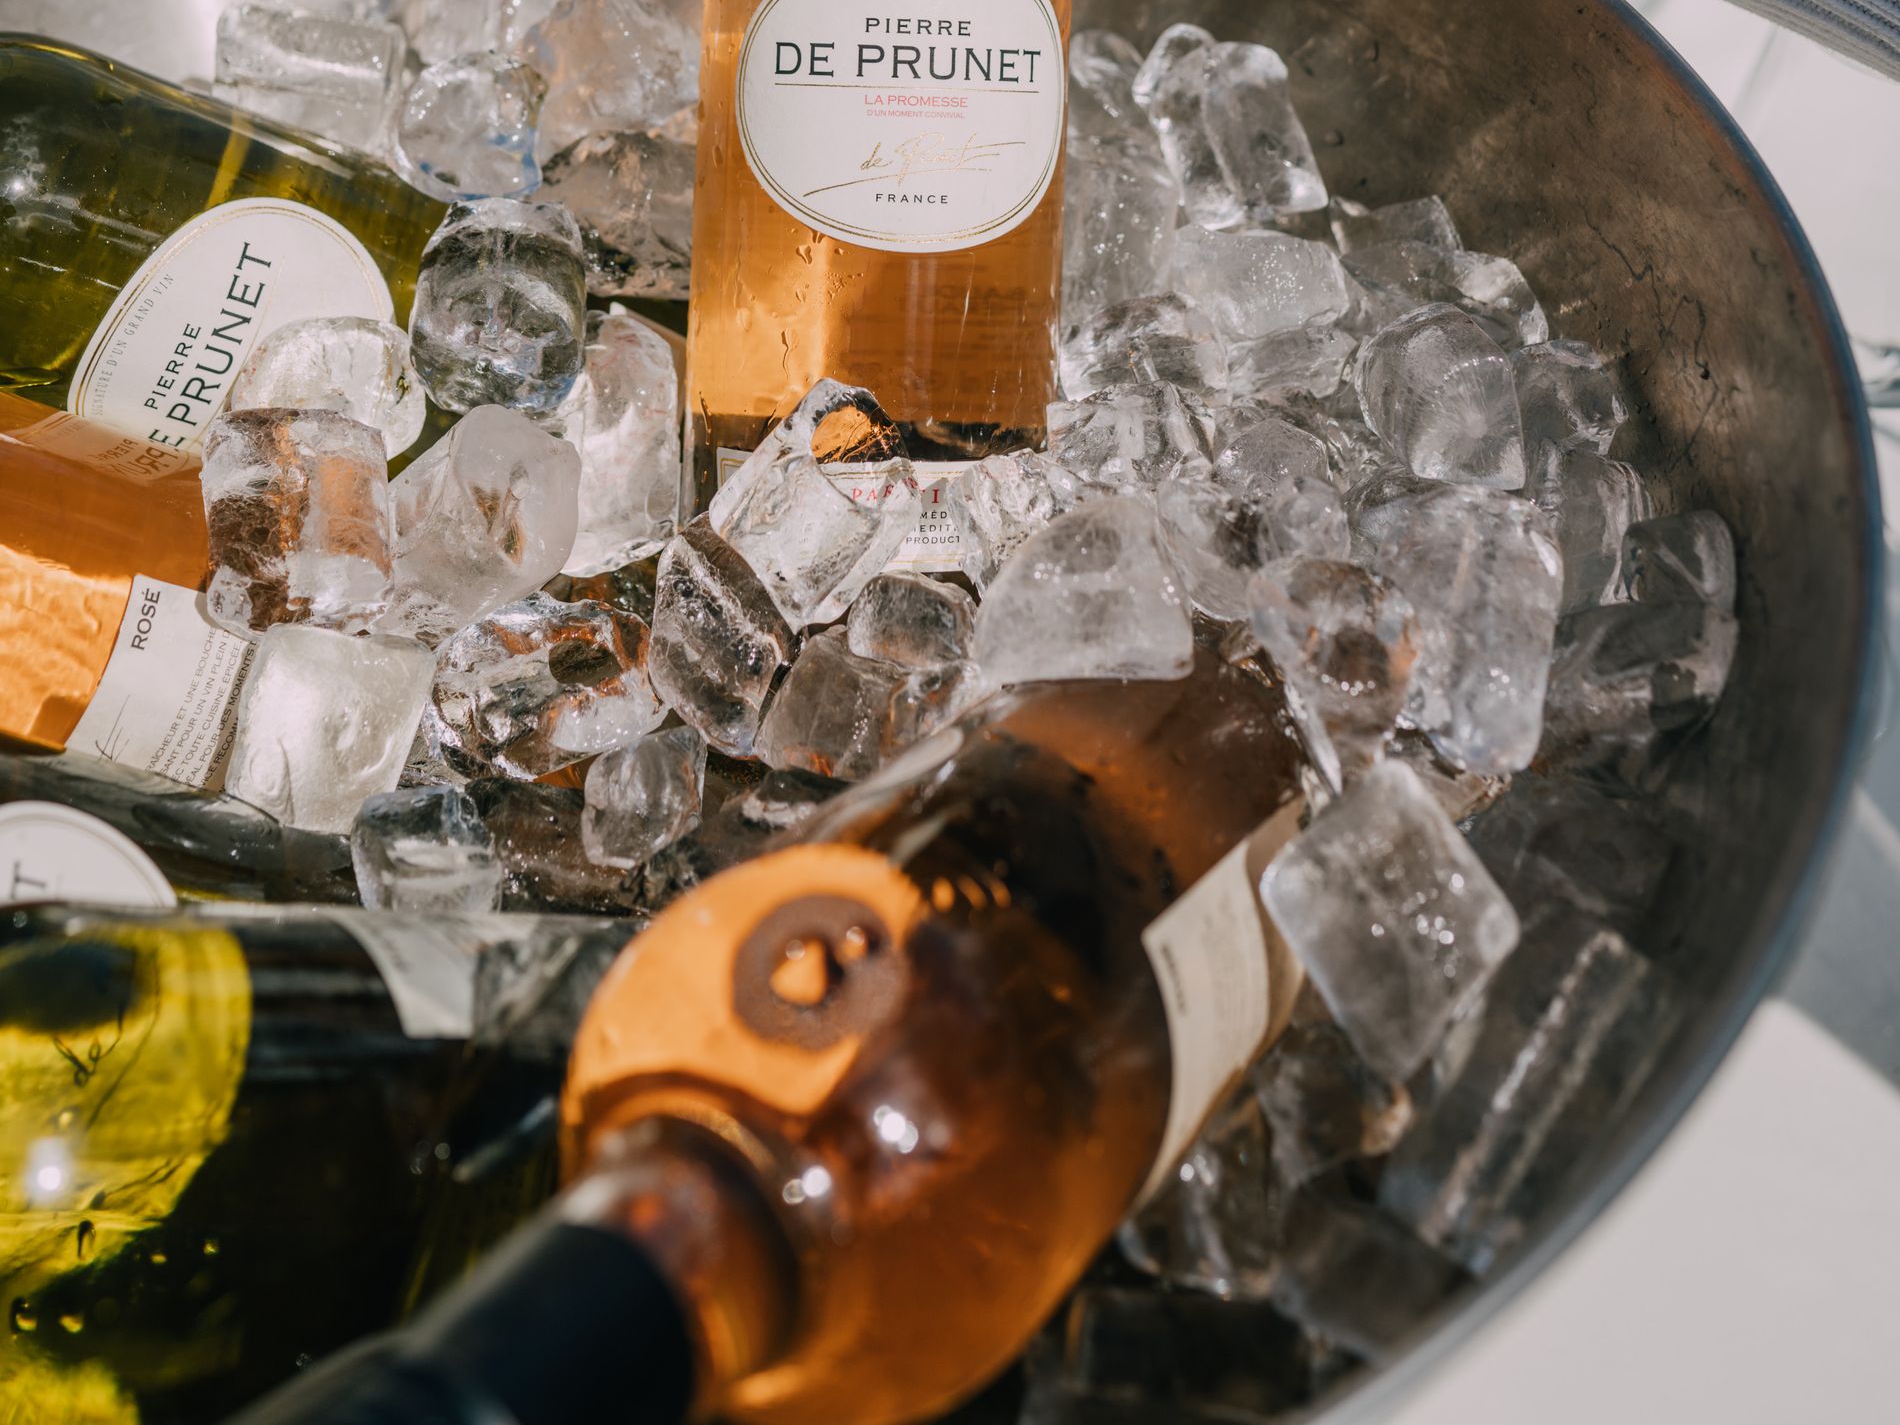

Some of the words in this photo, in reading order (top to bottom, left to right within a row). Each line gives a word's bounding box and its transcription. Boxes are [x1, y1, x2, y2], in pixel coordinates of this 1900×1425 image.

[865, 17, 971, 36] PIERRE
[774, 42, 835, 77] DE
[856, 44, 1041, 83] PRUNET
[864, 94, 885, 106] LA
[888, 95, 969, 108] PROMESSE
[888, 110, 924, 118] MOMENT
[875, 193, 949, 204] FRANCE
[106, 338, 127, 367] D'UN
[123, 298, 154, 336] GRAND
[152, 272, 174, 294] VIN
[166, 242, 272, 427] PRUNET
[144, 323, 201, 410] PIERRE
[131, 588, 160, 650] ROSÉ
[176, 705, 187, 719] ET
[184, 678, 199, 703] UNE
[177, 717, 197, 747] POUR
[194, 698, 206, 715] UN
[202, 676, 215, 696] VIN
[210, 640, 227, 674] PLEIN
[181, 732, 204, 763] TOUTE
[202, 686, 225, 730] CUISINE
[200, 732, 219, 761] POUR
[217, 707, 231, 730] DES
[228, 647, 254, 705] MOMENTS
